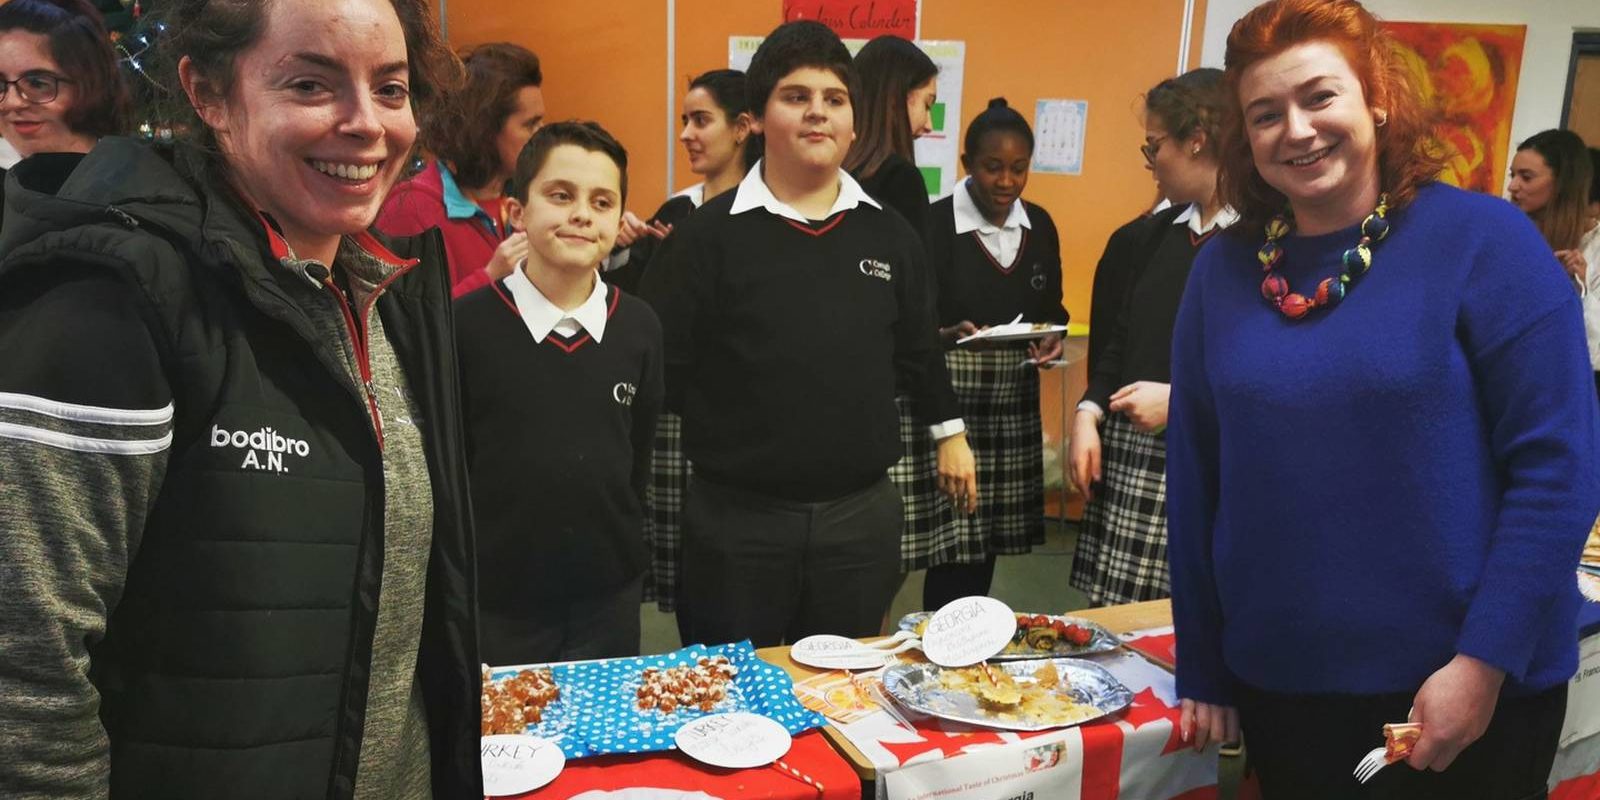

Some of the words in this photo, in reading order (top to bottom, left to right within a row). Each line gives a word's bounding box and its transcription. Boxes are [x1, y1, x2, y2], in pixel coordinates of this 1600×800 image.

[210, 423, 310, 457] bodibro
[241, 449, 289, 475] A.N.
[928, 601, 987, 634] GEORGIA
